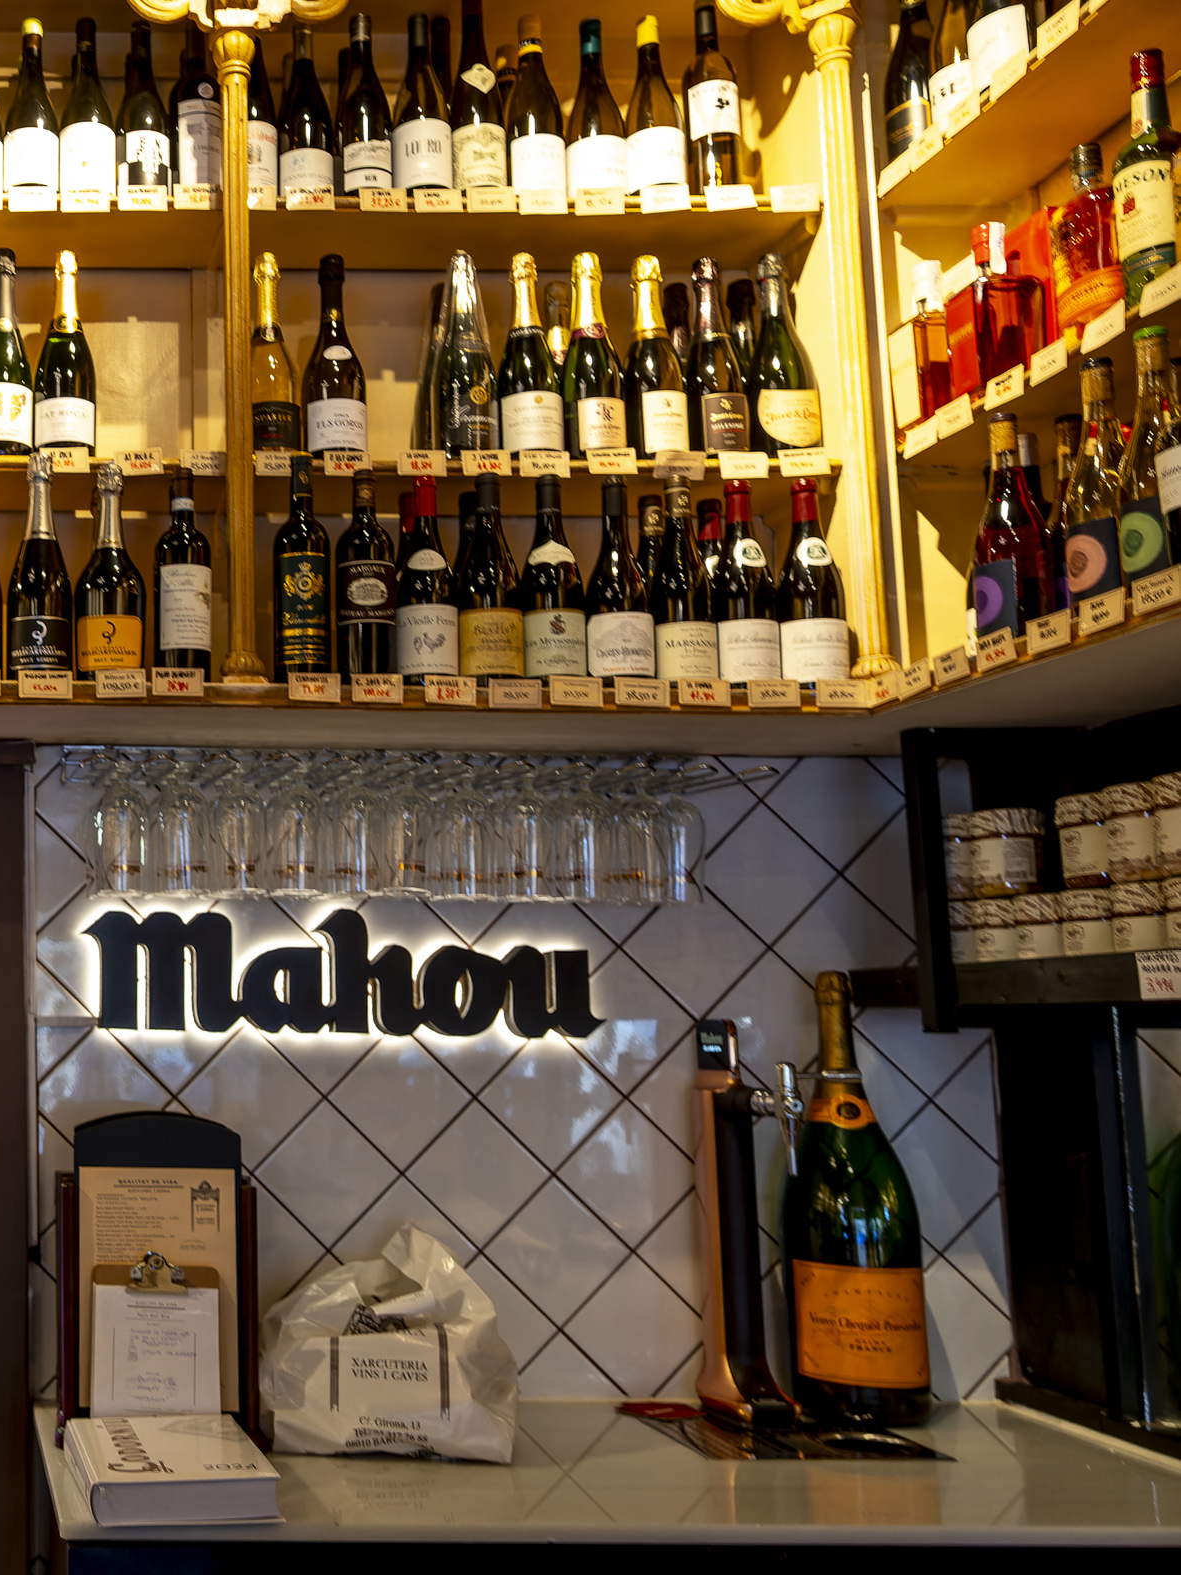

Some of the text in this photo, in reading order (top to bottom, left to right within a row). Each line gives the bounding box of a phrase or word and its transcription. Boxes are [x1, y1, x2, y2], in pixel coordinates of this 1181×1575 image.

[81, 909, 606, 1038] Mahou
[351, 1357, 428, 1372] XARCUTERIA
[351, 1368, 380, 1380] VINS
[391, 1371, 428, 1383] CAVES
